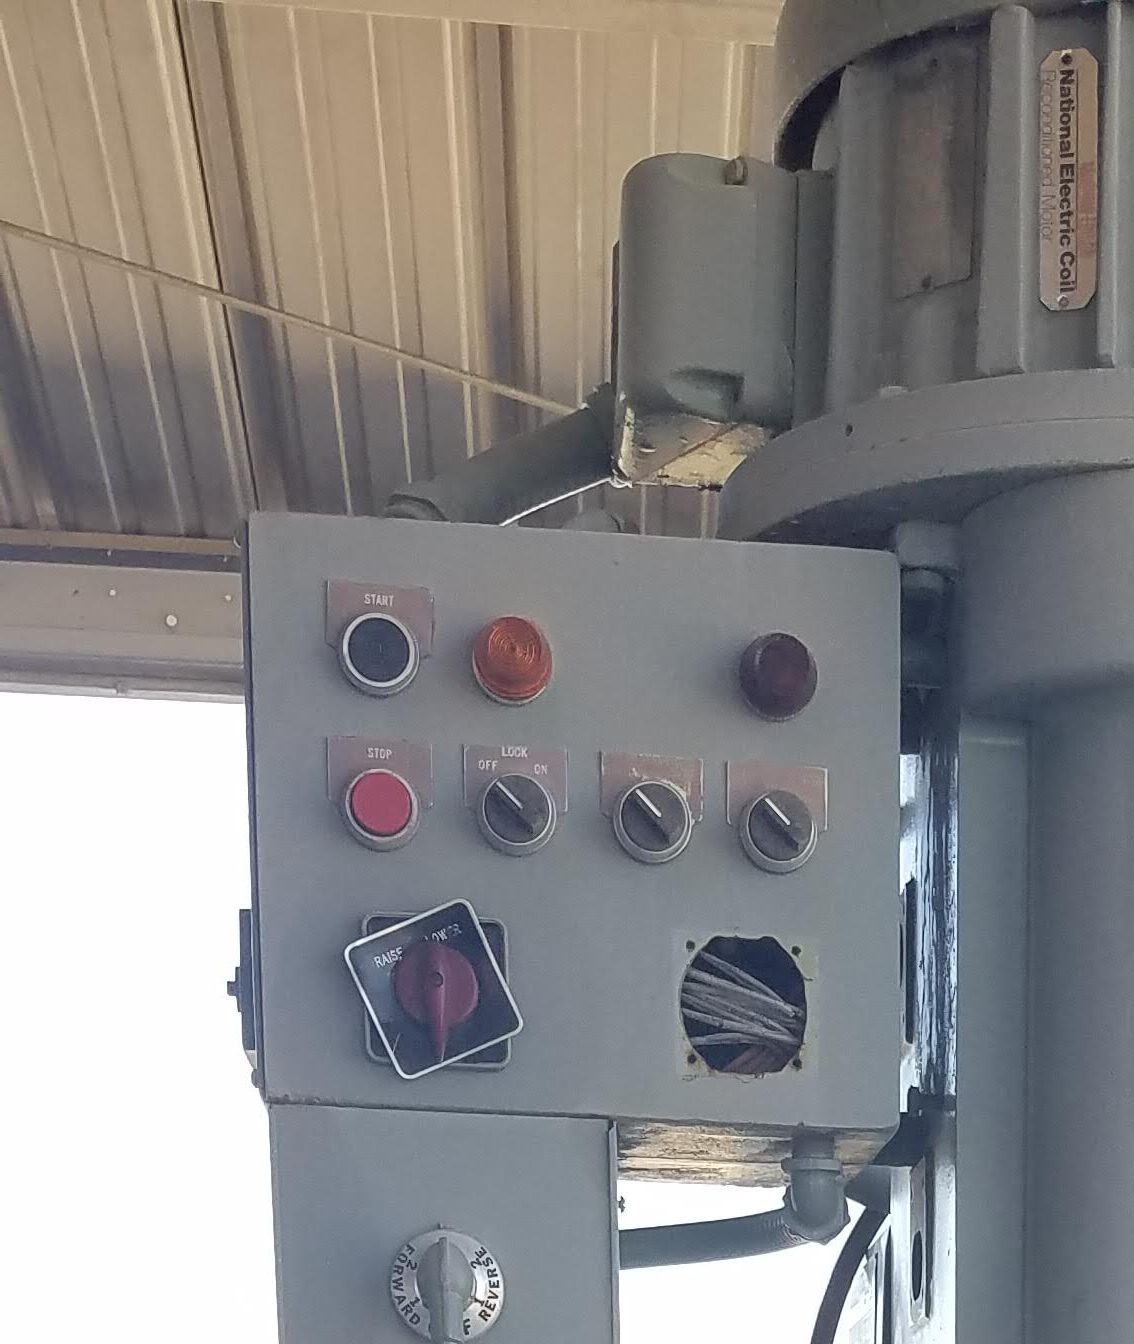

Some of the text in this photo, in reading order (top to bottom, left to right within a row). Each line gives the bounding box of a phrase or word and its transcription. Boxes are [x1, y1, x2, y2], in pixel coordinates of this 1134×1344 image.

[1041, 70, 1056, 242] Reconditioned Motor
[1060, 69, 1075, 293] National Electric Coil
[364, 593, 394, 607] START
[367, 747, 392, 760] STOP
[501, 746, 528, 758] LOCK
[478, 760, 498, 770] OFF
[534, 764, 548, 775] ON
[406, 1260, 418, 1271] 2
[470, 1257, 483, 1269] 2
[391, 1244, 421, 1326] FORWARD
[475, 1246, 500, 1322] REVERSE
[409, 1296, 421, 1307] 1
